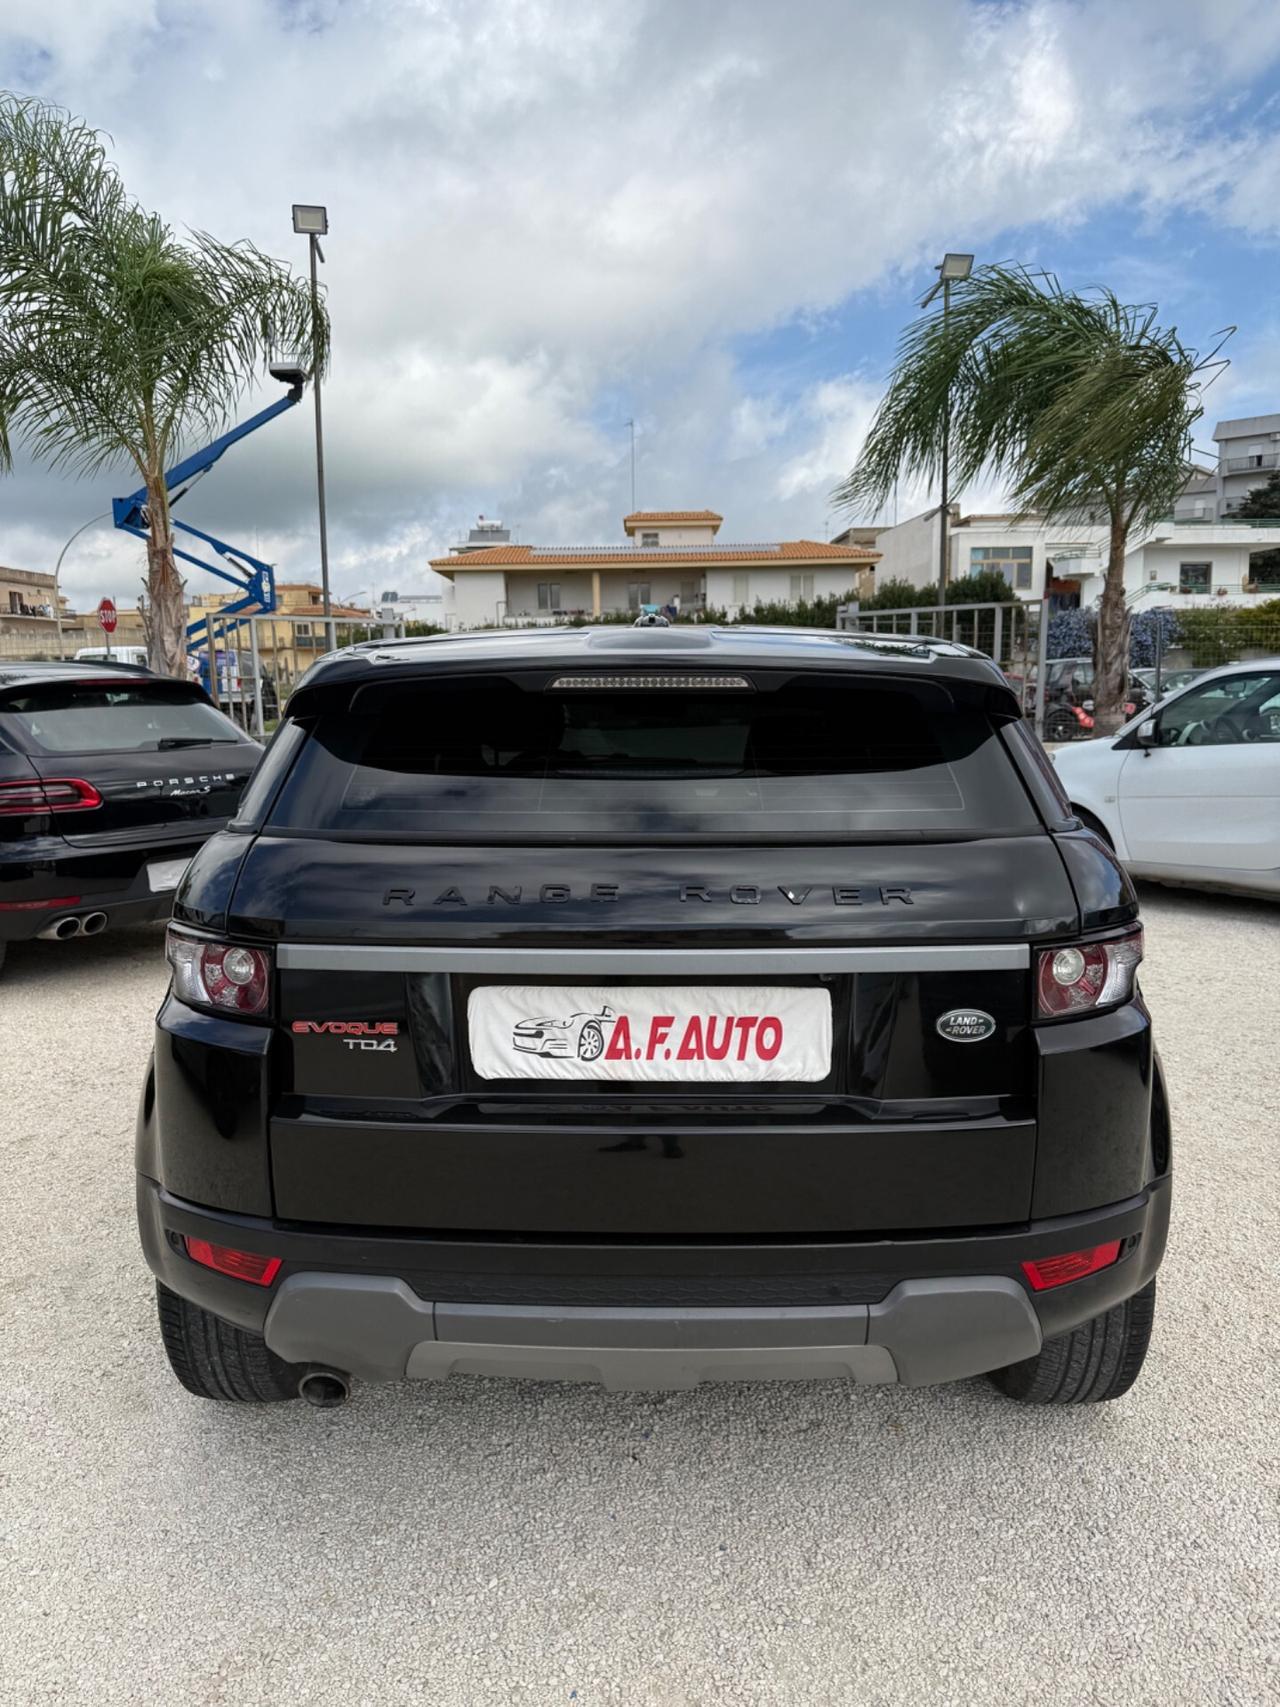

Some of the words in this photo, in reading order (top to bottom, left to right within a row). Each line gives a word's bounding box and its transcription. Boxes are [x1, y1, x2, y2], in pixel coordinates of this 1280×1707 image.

[100, 609, 116, 623] STOP
[137, 774, 235, 788] PORSCHE
[382, 884, 619, 906] RANGE
[679, 886, 914, 906] ROVER
[291, 1020, 399, 1035] EVOQUE
[343, 1038, 398, 1052] TD4
